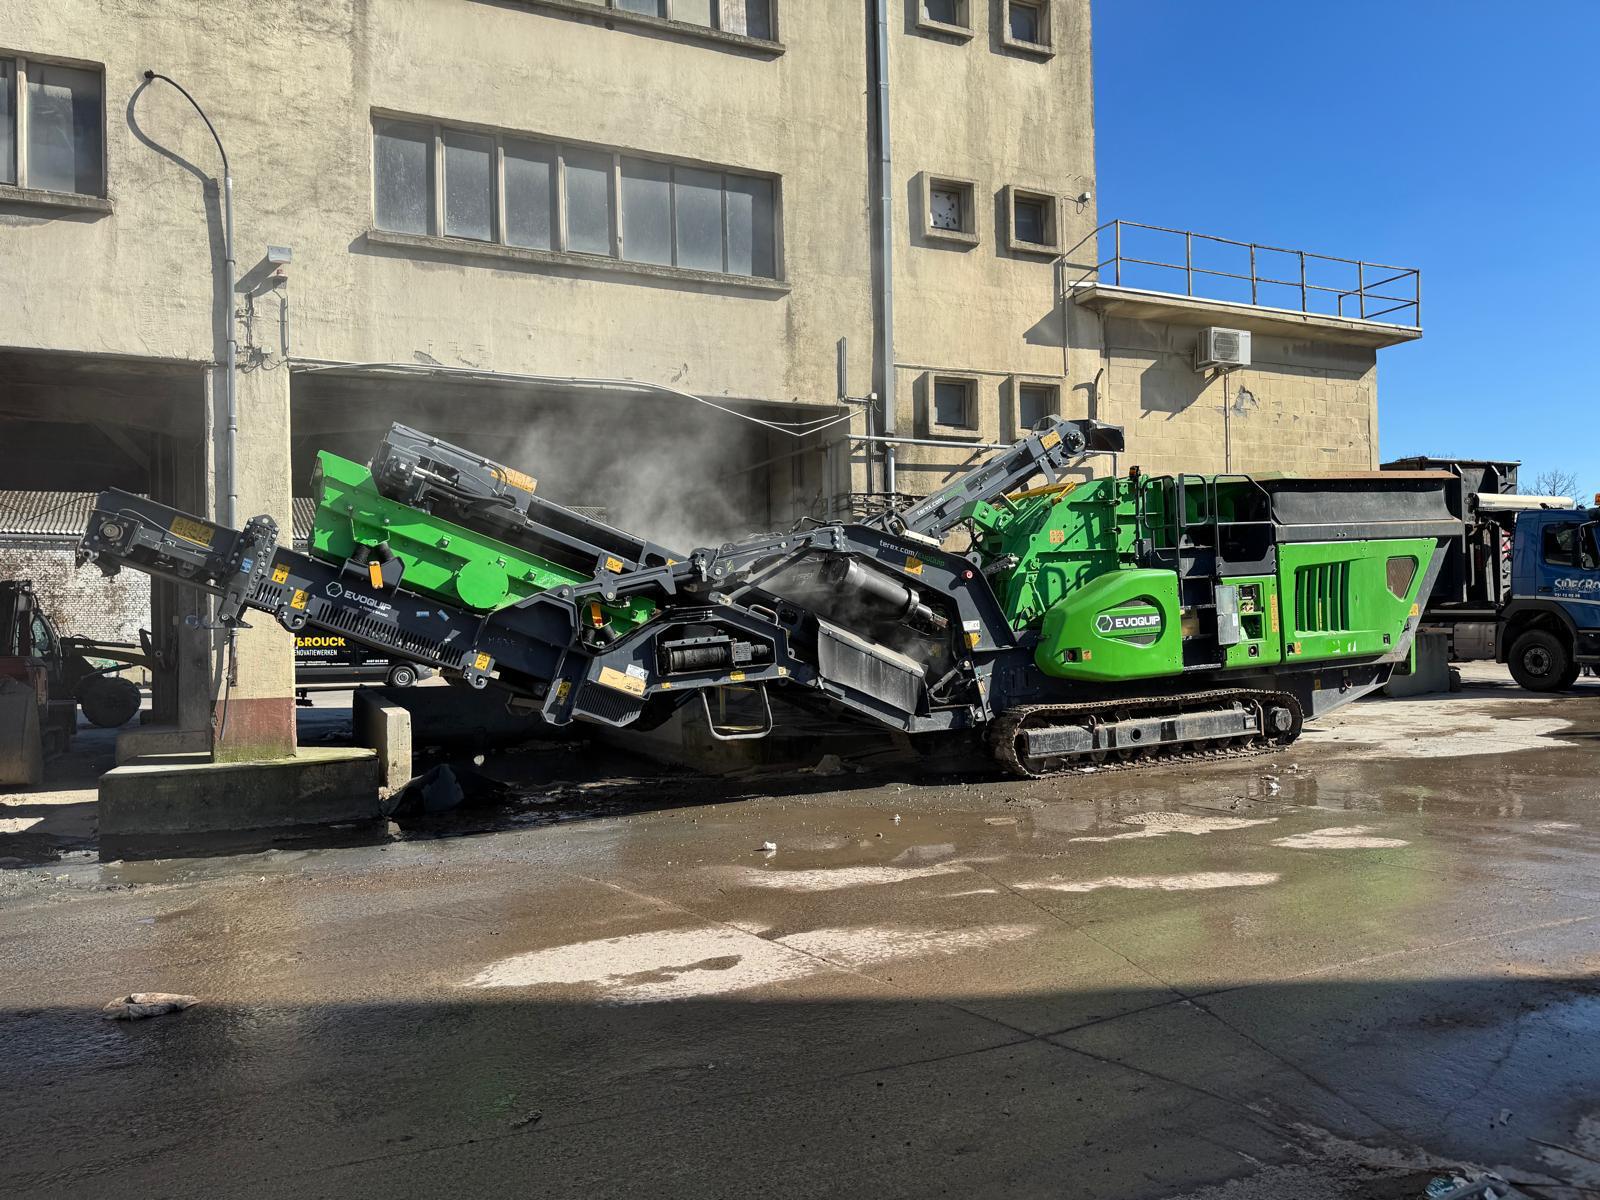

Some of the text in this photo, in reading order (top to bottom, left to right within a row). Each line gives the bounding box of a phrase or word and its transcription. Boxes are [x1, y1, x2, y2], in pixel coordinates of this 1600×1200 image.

[344, 590, 392, 611] EVOQUIP
[1115, 616, 1160, 628] EVOQUIP
[294, 648, 338, 656] ENOVATIEWERKEN
